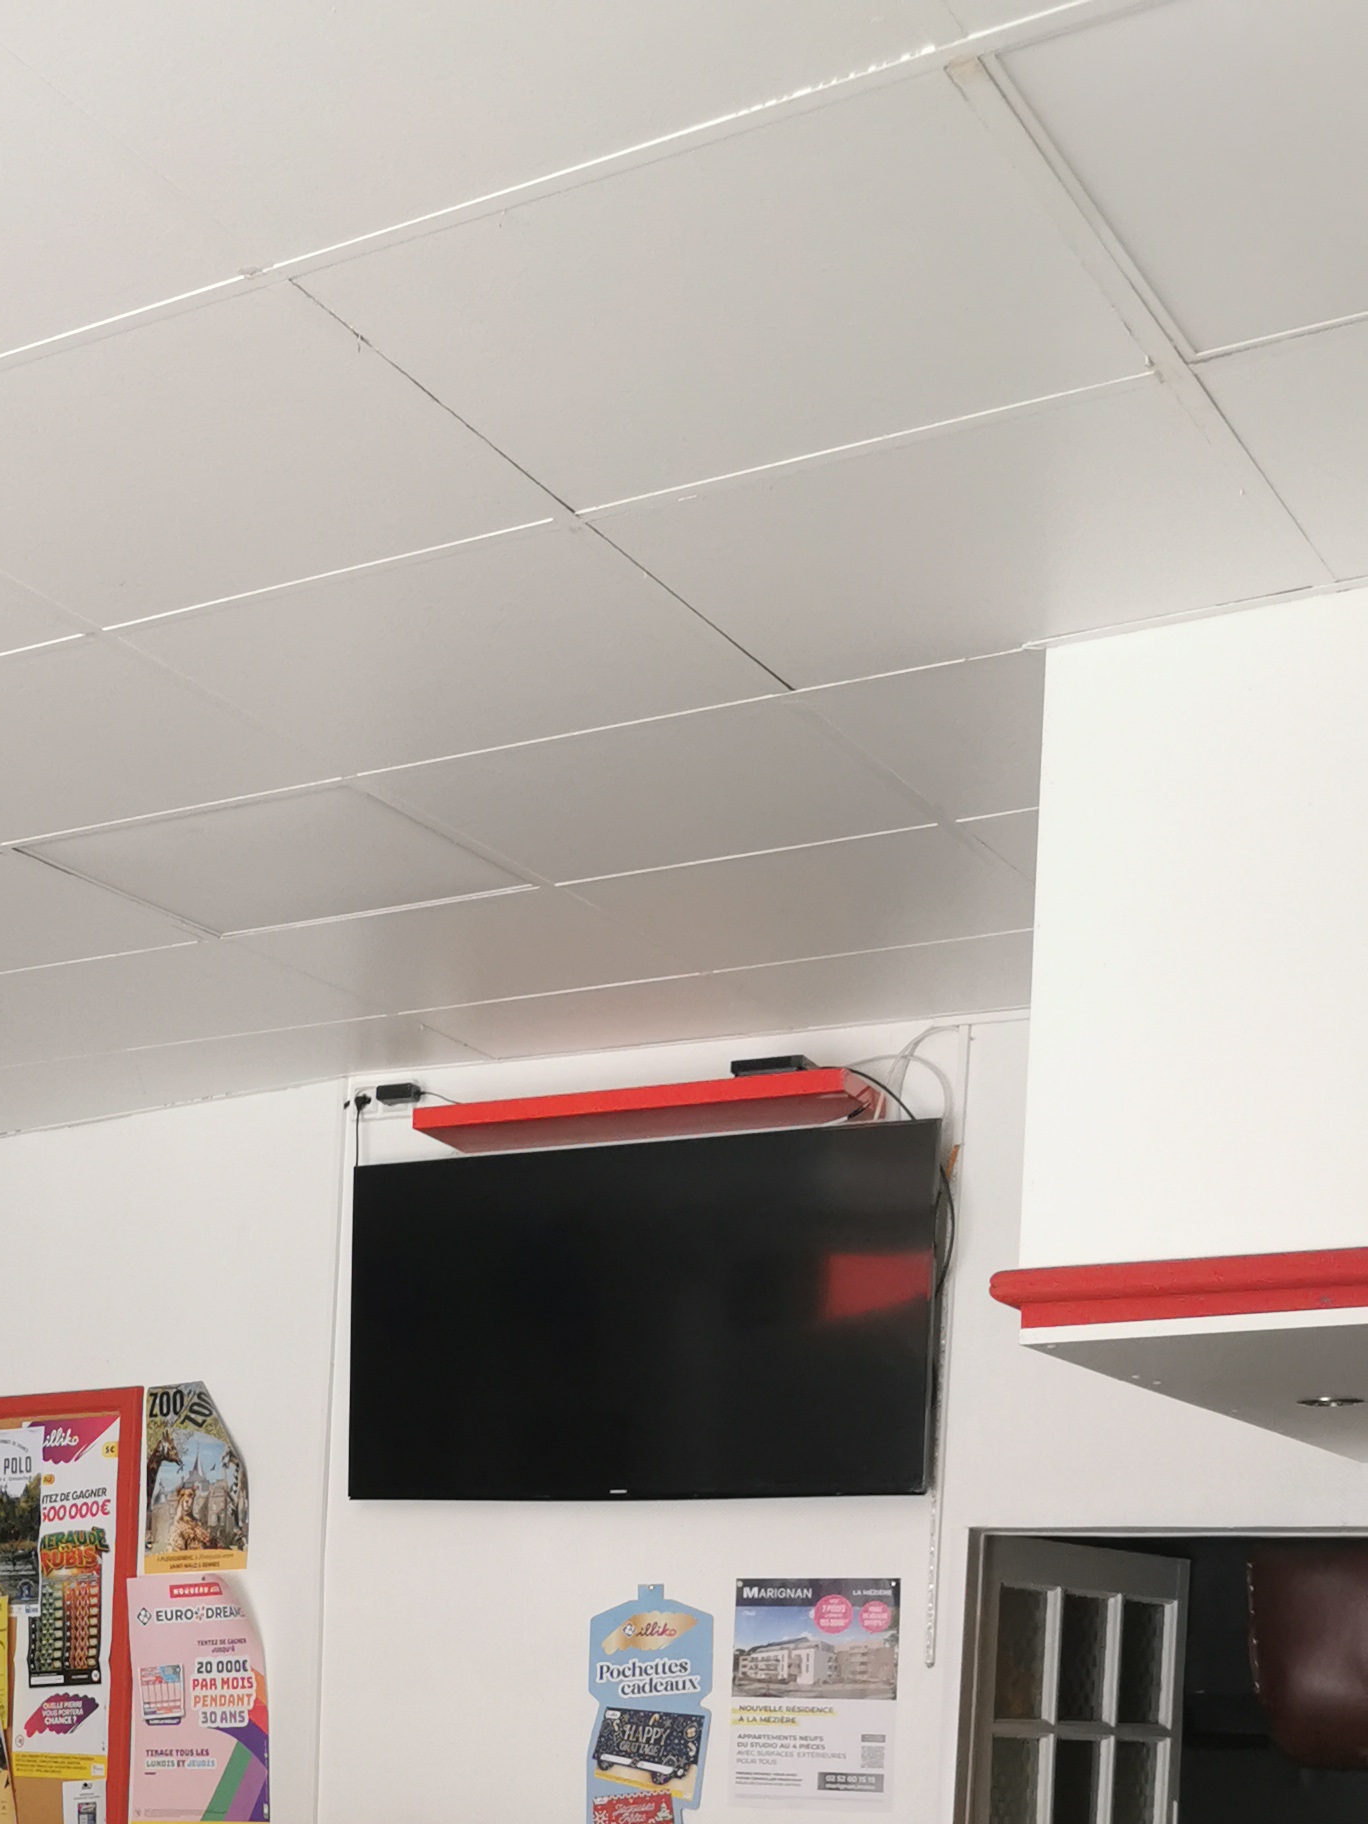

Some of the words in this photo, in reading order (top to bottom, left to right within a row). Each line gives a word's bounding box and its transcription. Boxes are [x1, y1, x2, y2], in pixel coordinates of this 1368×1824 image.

[149, 1390, 184, 1418] ZOO
[43, 1427, 79, 1447] illiko
[4, 1456, 32, 1475] POLO
[60, 1492, 70, 1501] DE
[72, 1487, 107, 1500] GAGNER
[41, 1526, 110, 1552] ERAUDE
[173, 1587, 209, 1595] NOUVEAU
[743, 1586, 812, 1599] MARIGNAN
[636, 1621, 677, 1637] illiko
[197, 1661, 213, 1674] 20
[216, 1660, 248, 1673] 000€
[599, 1660, 689, 1681] Pochettes
[192, 1678, 217, 1691] PAR
[221, 1677, 253, 1690] MOIS
[620, 1677, 699, 1696] cadeaux
[193, 1694, 253, 1708] PENDANT
[785, 1705, 834, 1713] RÉSIDENCE
[44, 1716, 70, 1725] CHANCE
[201, 1711, 217, 1724] 30
[220, 1710, 245, 1723] ANS
[623, 1724, 670, 1745] HAPPY
[146, 1749, 173, 1757] TIRAGE
[196, 1748, 209, 1756] LES
[146, 1760, 175, 1768] LUNDIS
